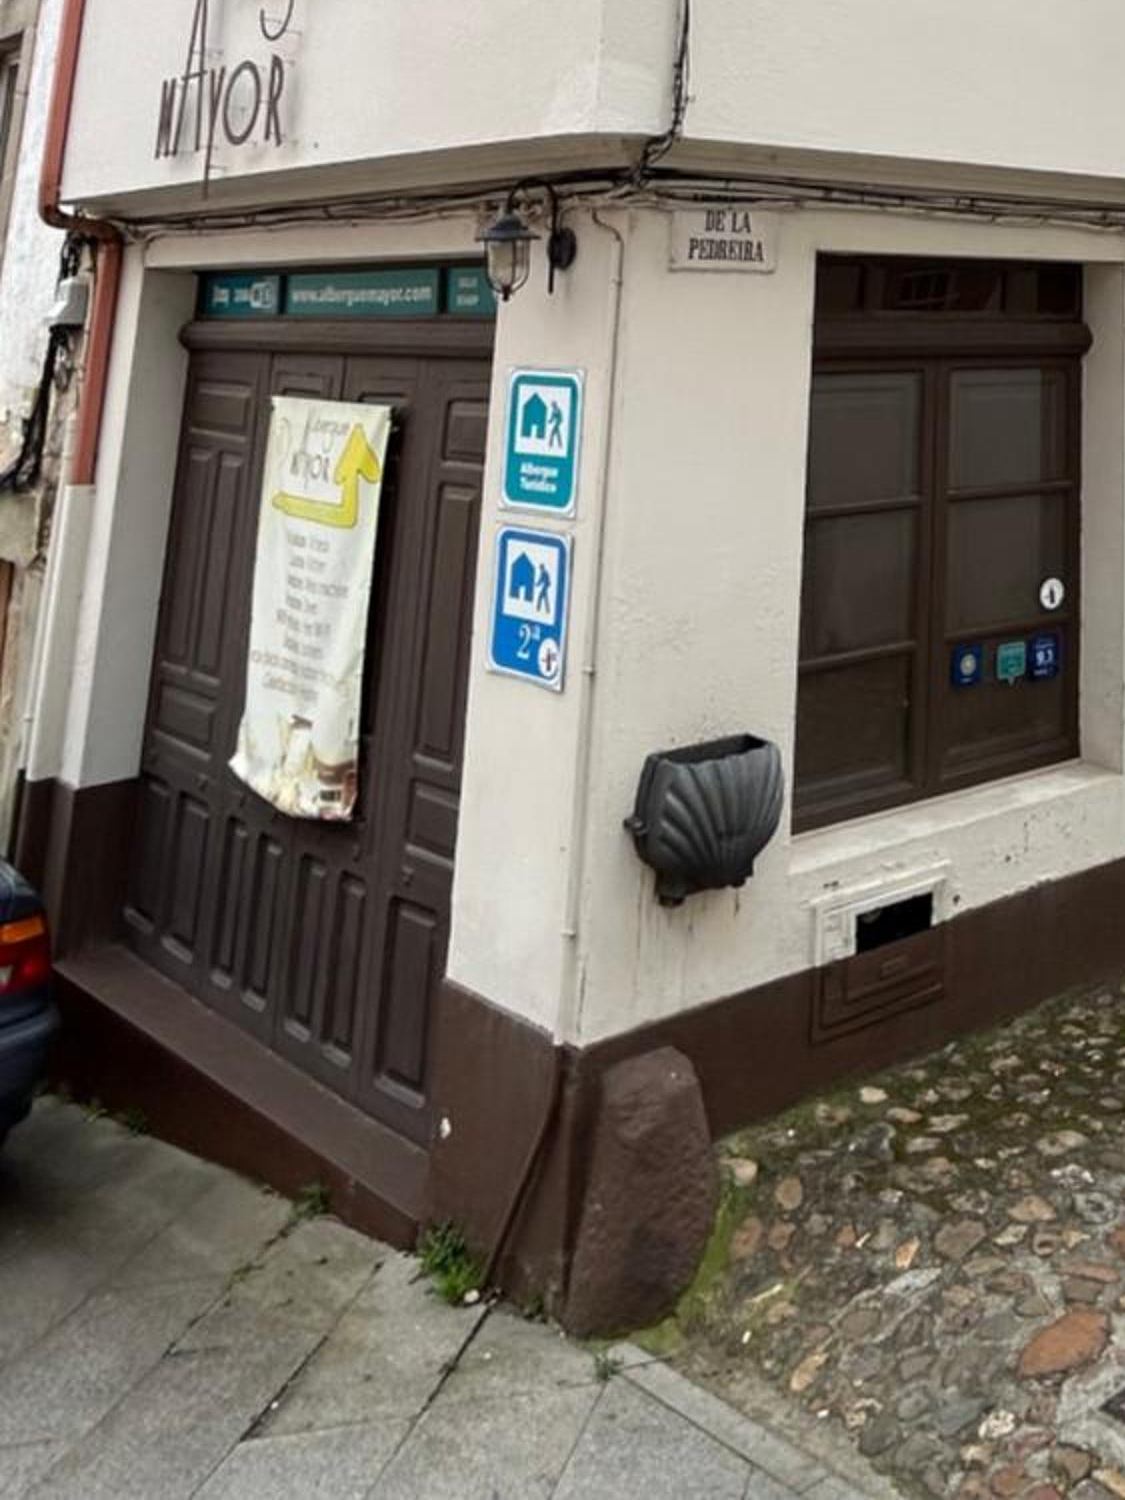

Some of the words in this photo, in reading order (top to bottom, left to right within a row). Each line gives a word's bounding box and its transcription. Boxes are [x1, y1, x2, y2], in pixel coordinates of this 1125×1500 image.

[705, 209, 726, 232] DE
[731, 210, 751, 233] LA
[688, 237, 764, 262] PEDREIRA
